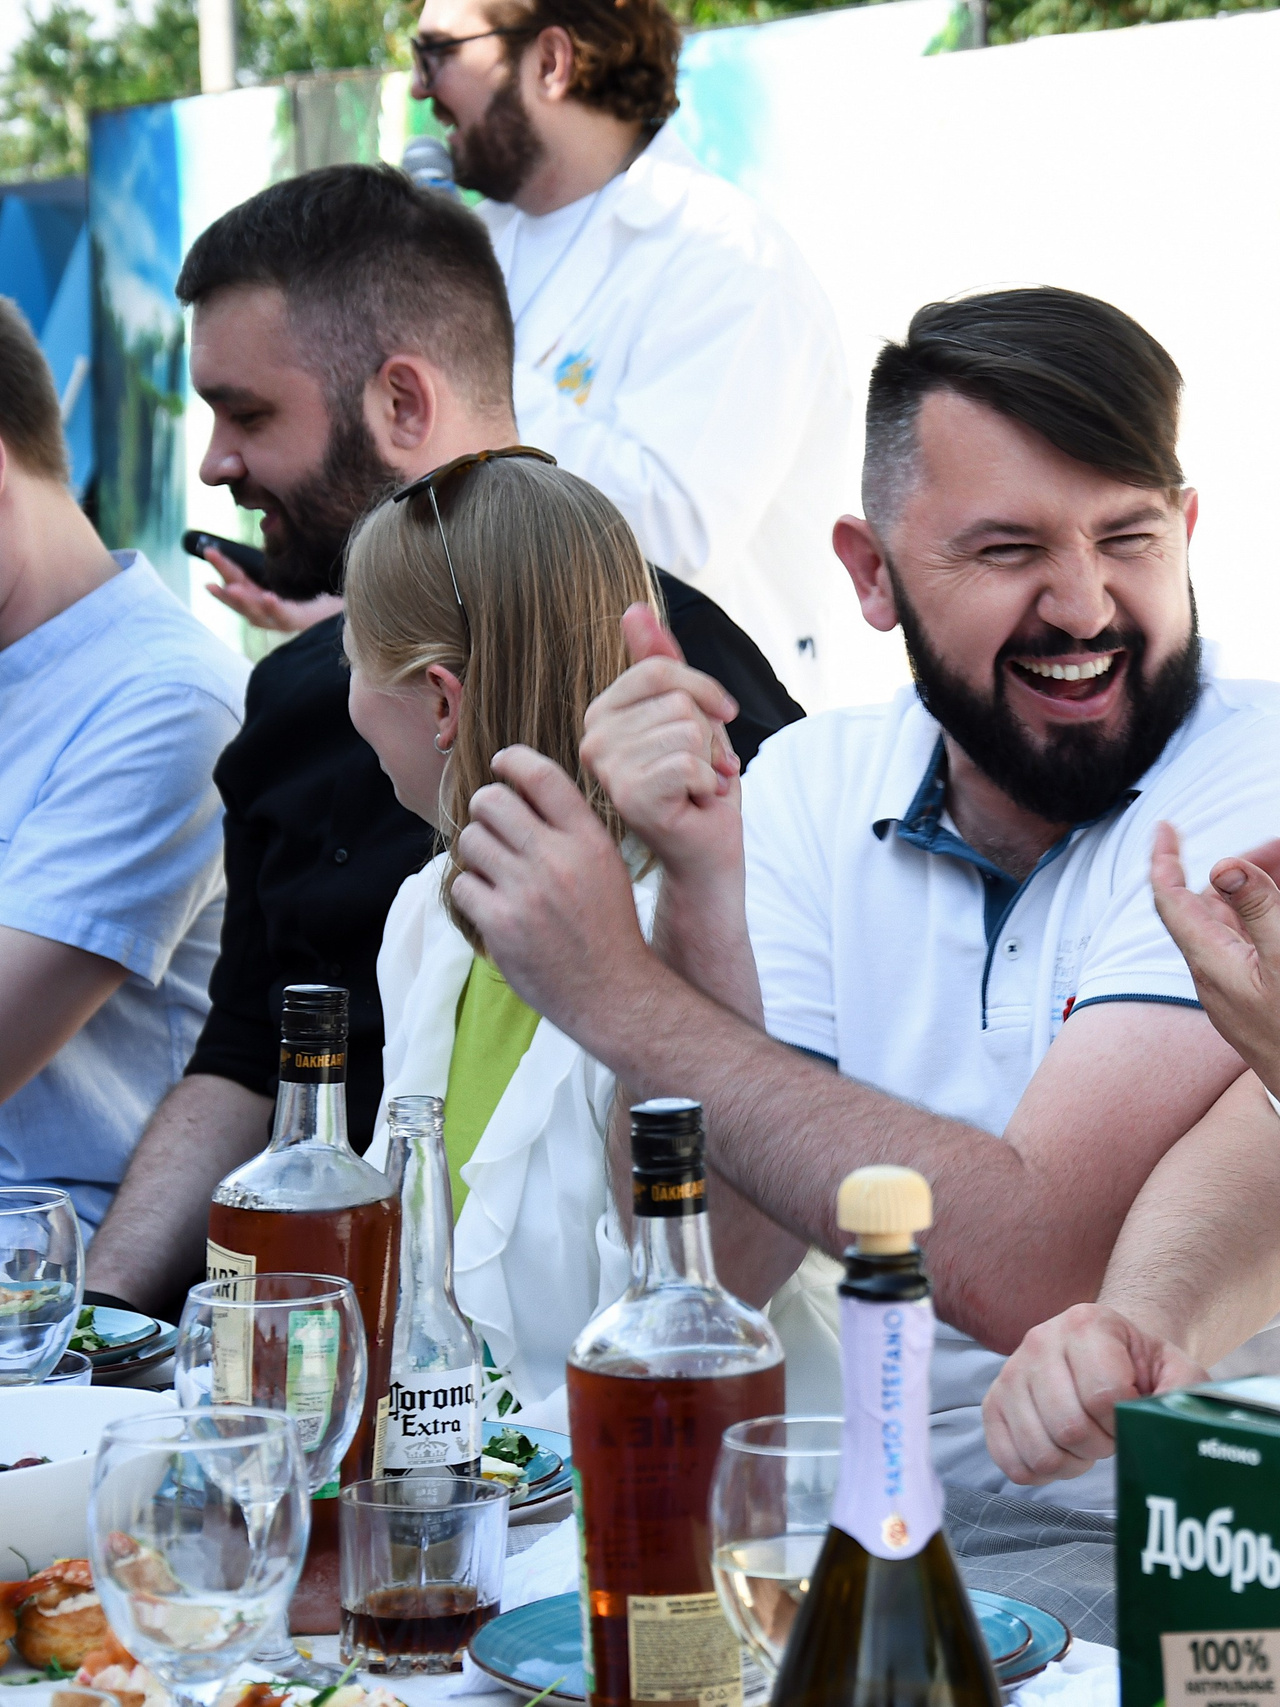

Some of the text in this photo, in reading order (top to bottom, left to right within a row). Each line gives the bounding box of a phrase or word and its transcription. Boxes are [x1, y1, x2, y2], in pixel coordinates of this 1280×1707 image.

[389, 1381, 475, 1421] Corona
[882, 1308, 904, 1496] SANTO STEFANO
[402, 1413, 461, 1437] Extra
[1198, 1437, 1262, 1467] яблоко
[1189, 1637, 1271, 1673] 100%
